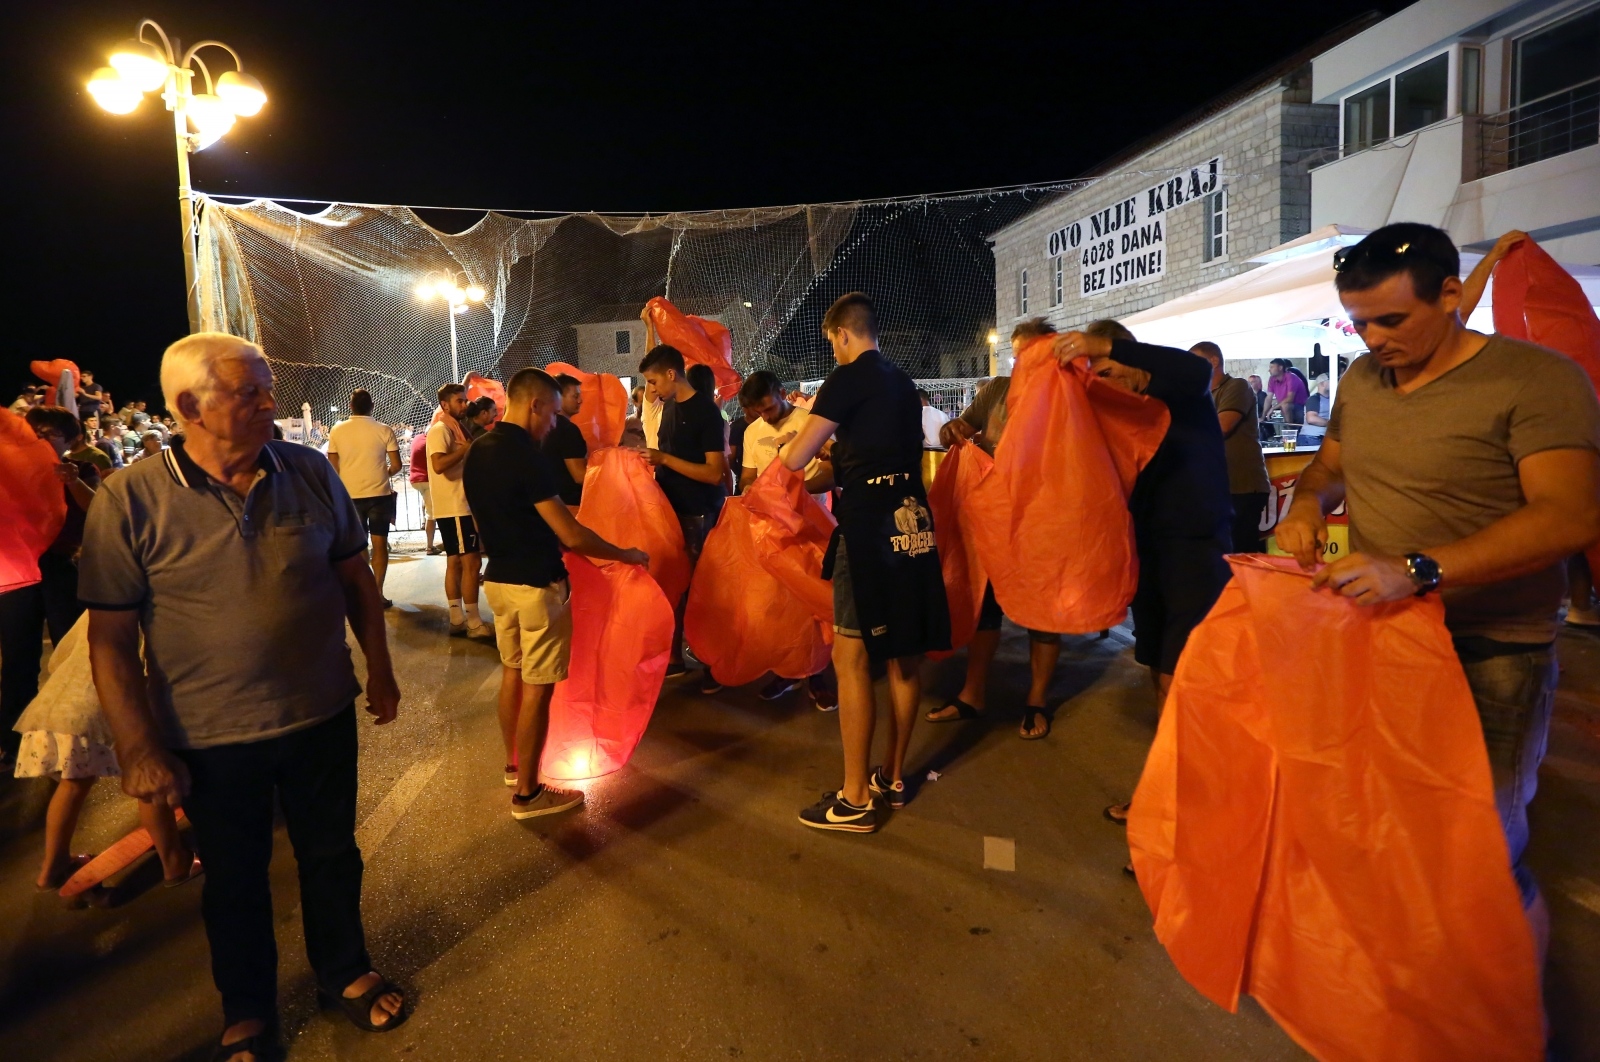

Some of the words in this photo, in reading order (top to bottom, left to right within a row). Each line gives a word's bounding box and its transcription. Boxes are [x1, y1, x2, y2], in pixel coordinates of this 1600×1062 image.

[1049, 223, 1081, 256] OVO
[1089, 197, 1136, 240] NIJE
[1147, 157, 1219, 218] KRAJ
[1082, 238, 1114, 267] 4028
[1121, 221, 1163, 255] DANA
[1083, 268, 1105, 293] BEZ
[1110, 250, 1162, 286] ISTINE!
